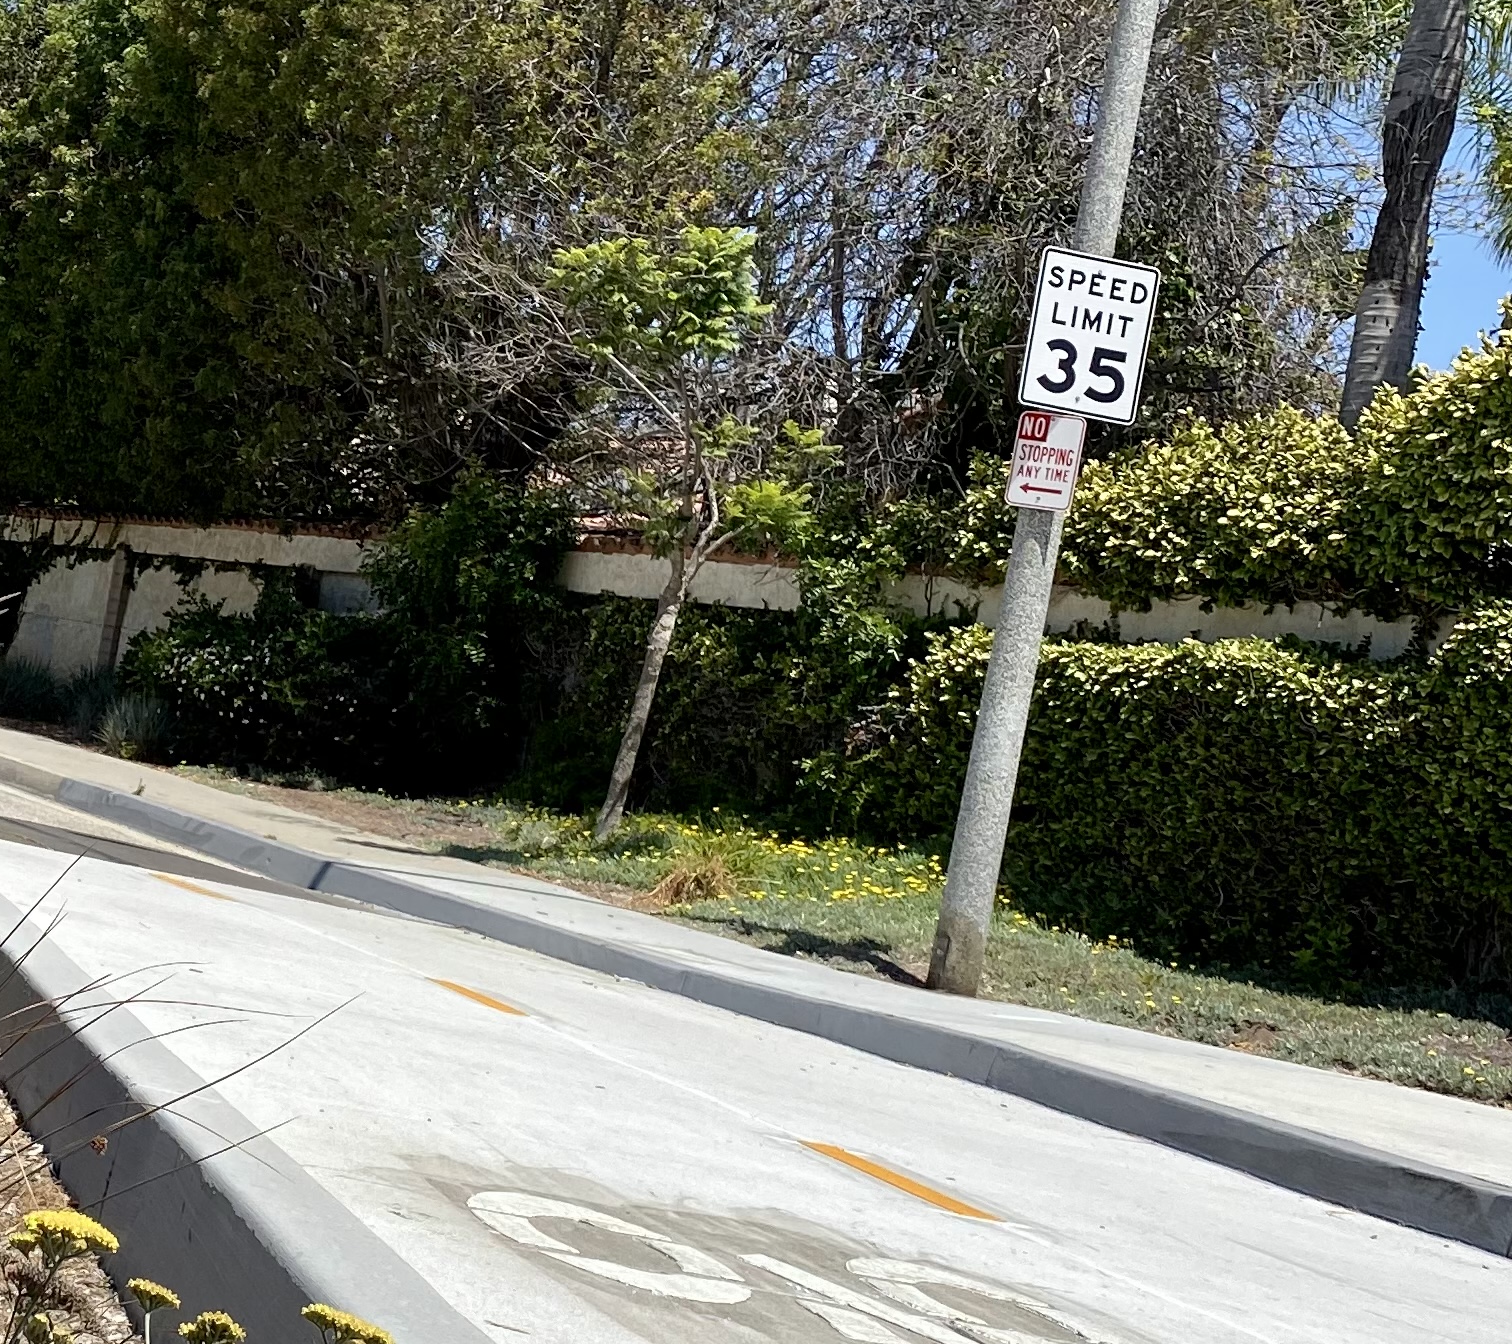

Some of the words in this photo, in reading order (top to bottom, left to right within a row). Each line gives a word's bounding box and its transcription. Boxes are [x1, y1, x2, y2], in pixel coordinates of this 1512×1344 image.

[1047, 265, 1149, 304] SPEED
[1051, 301, 1134, 338] LIMIT
[1036, 338, 1128, 404] 35
[1021, 415, 1047, 439] NO
[1018, 443, 1075, 467] STOPPING
[1017, 465, 1041, 479] ANY
[1044, 467, 1070, 483] TIME
